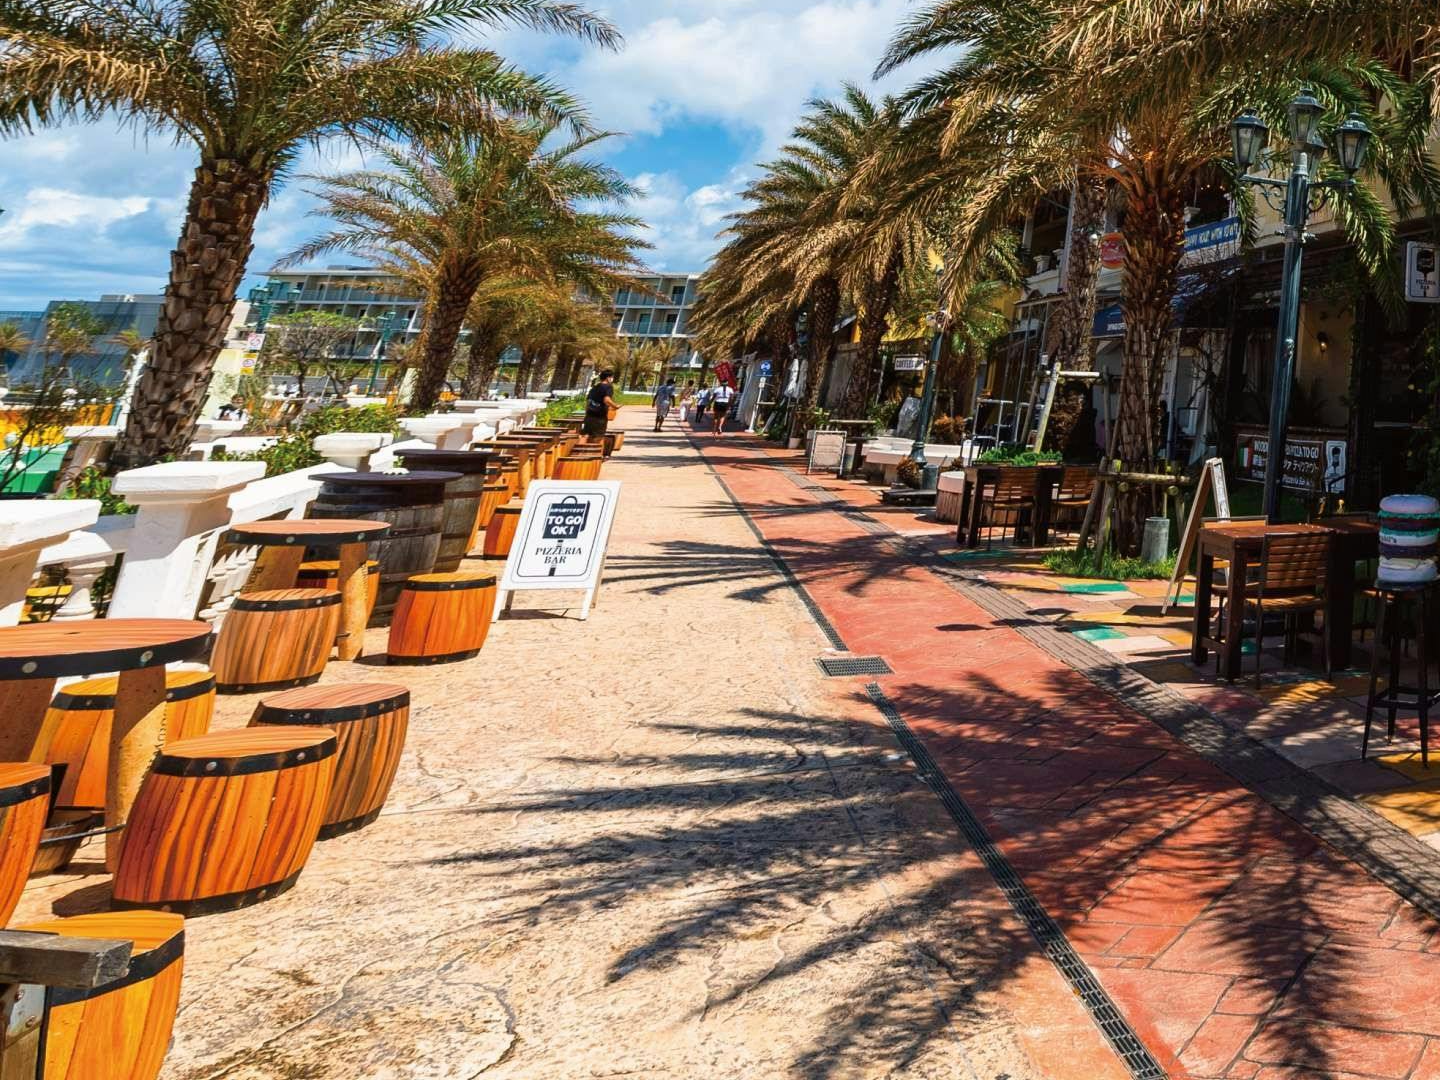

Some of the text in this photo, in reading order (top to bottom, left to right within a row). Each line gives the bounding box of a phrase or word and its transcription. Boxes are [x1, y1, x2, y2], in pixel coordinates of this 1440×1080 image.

[548, 515, 582, 525] TO GO
[535, 547, 582, 556] PIZZERIA
[544, 556, 567, 564] BAR
